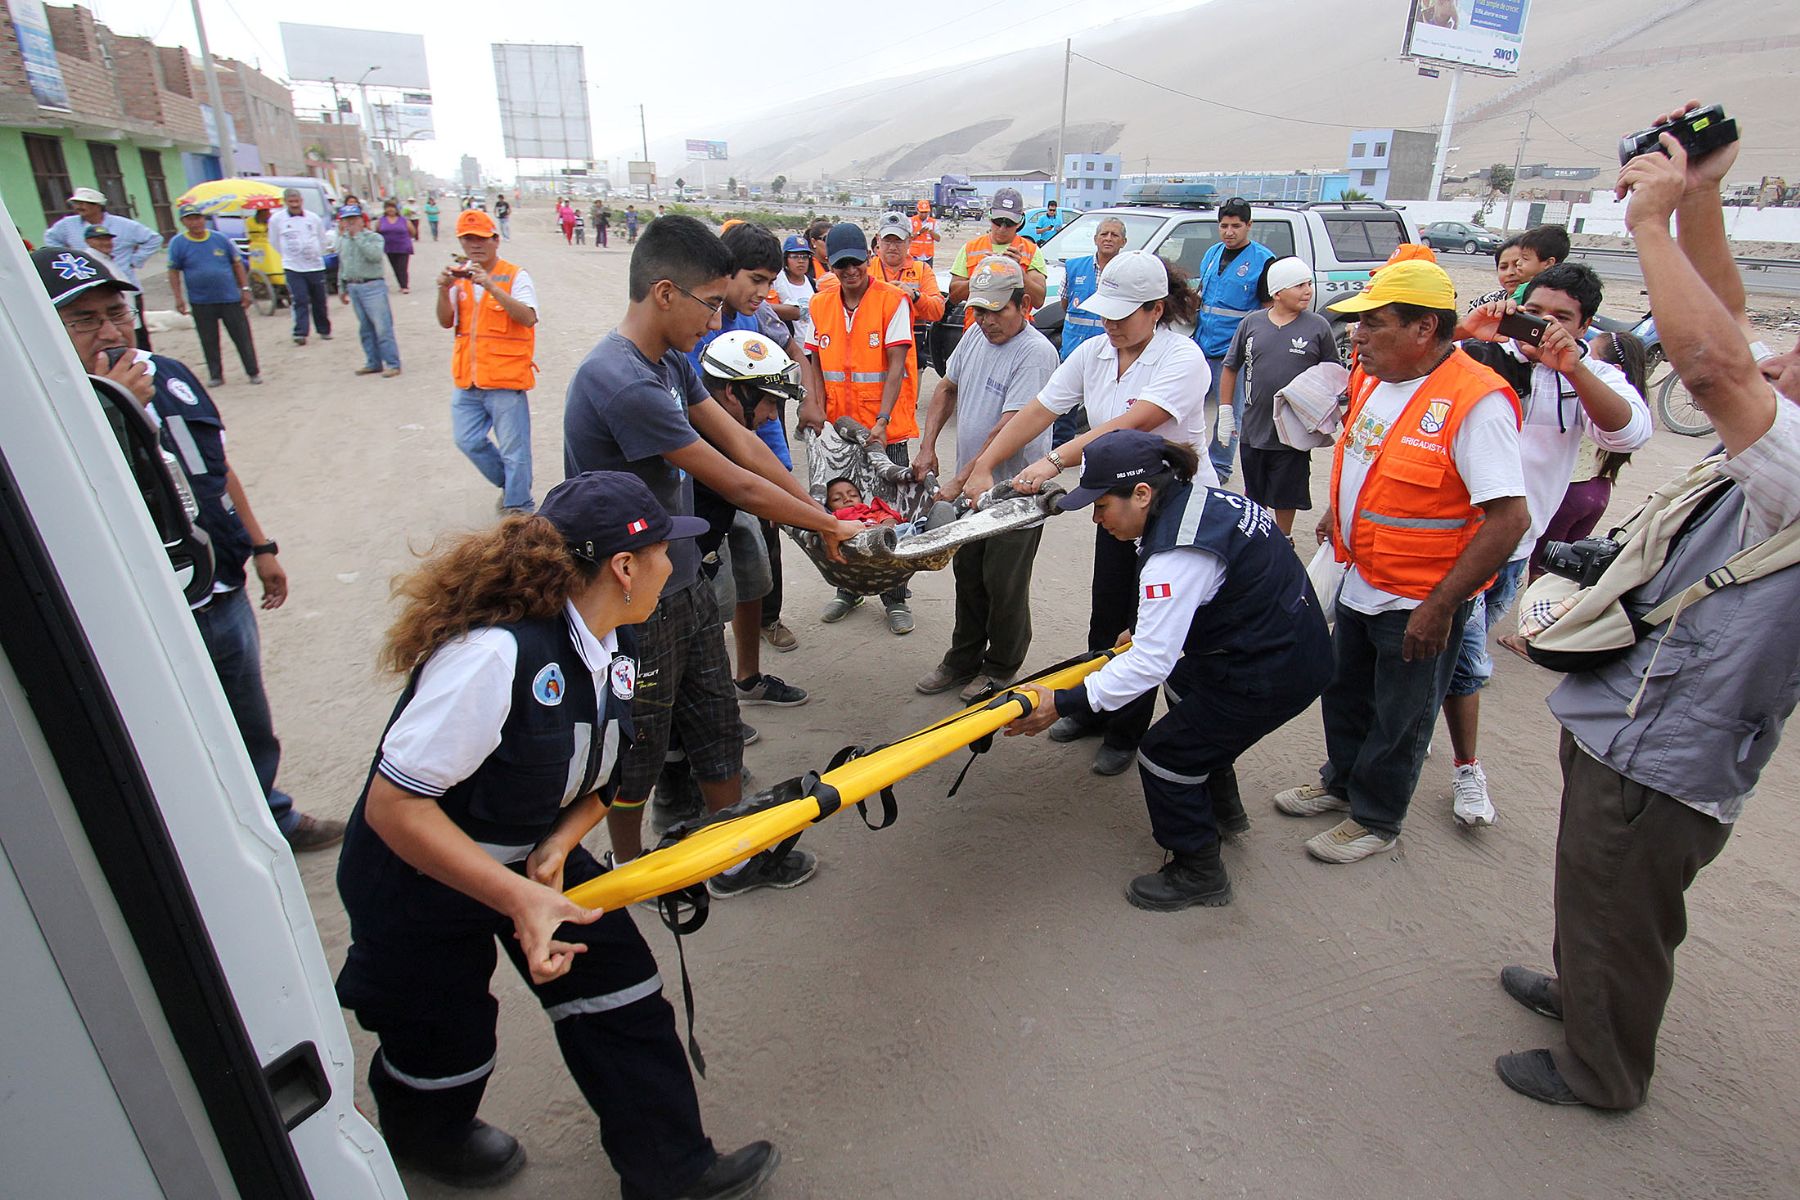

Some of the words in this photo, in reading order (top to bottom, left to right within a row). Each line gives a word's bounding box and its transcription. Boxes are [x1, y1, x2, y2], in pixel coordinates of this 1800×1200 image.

[1493, 48, 1512, 61] sura
[1326, 281, 1365, 292] 313
[1400, 436, 1448, 456] BRIGADISTA
